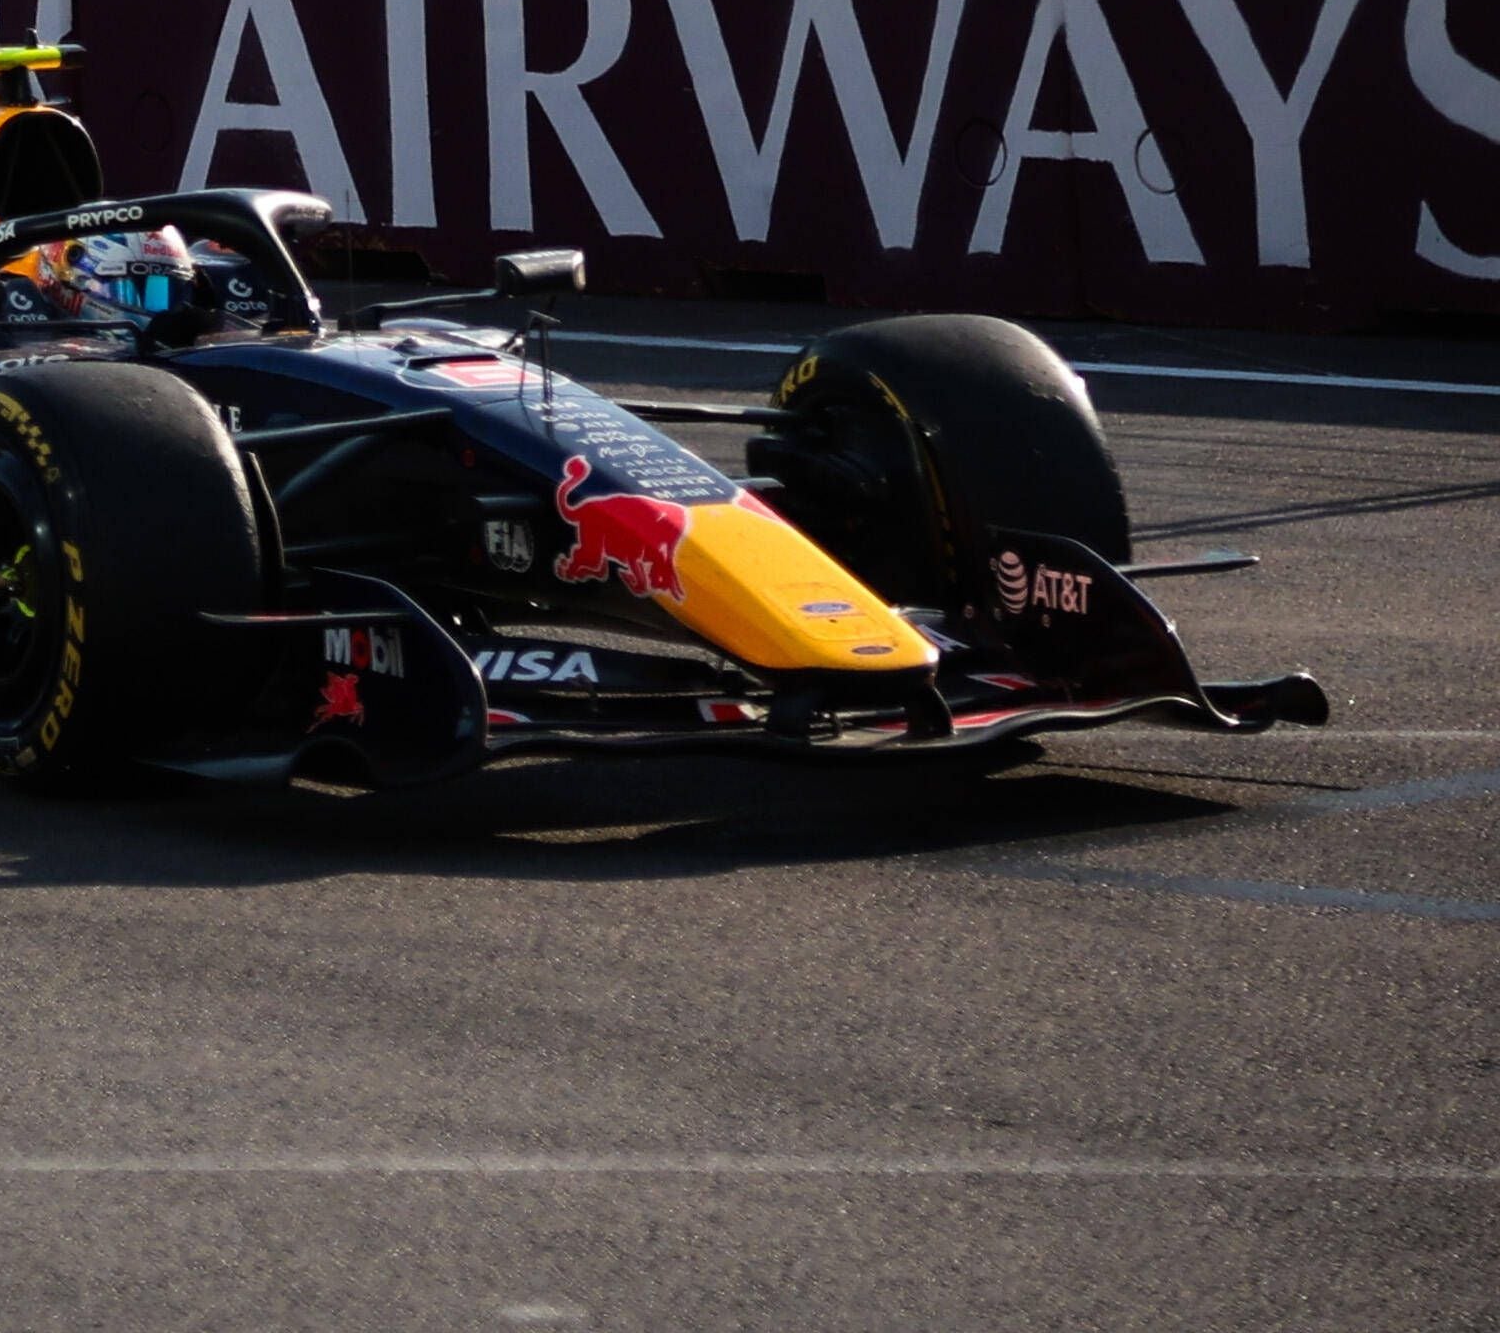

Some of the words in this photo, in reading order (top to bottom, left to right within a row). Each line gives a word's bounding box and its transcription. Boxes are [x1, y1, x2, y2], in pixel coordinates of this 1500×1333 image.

[66, 204, 144, 230] PRYPCO
[1032, 569, 1093, 614] AT&T
[39, 595, 86, 754] ZERO
[324, 627, 405, 679] Mobil
[474, 650, 599, 684] VISA
